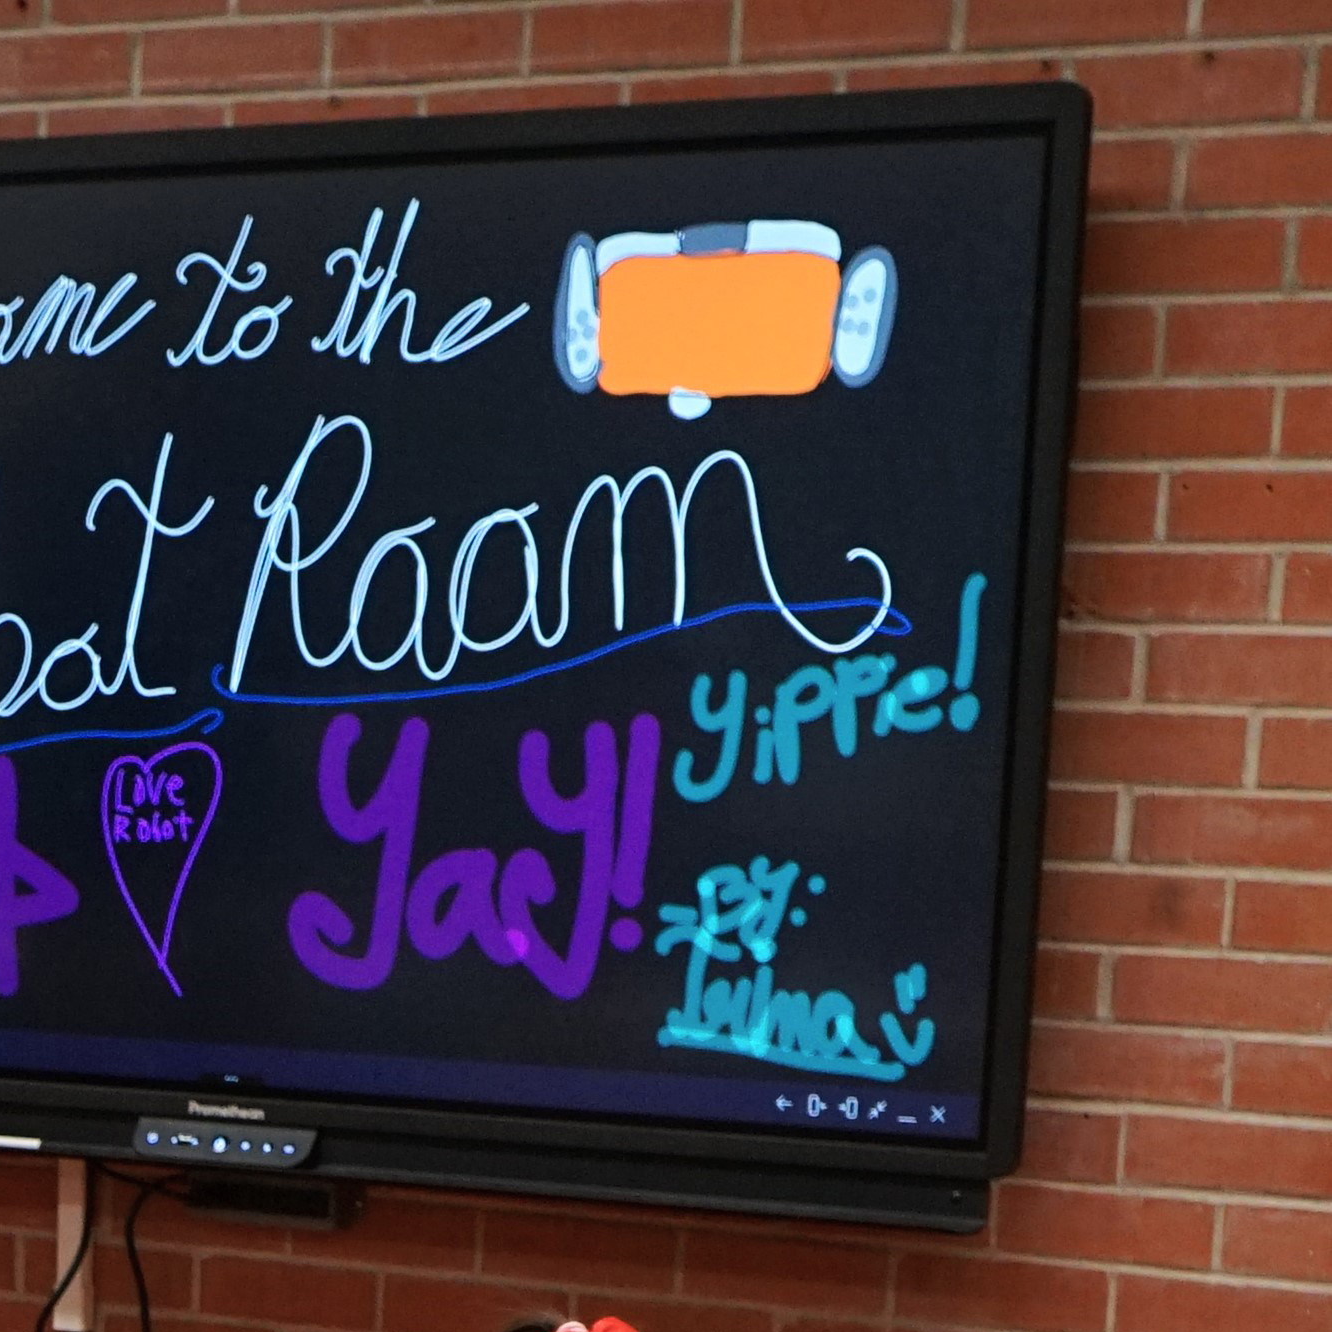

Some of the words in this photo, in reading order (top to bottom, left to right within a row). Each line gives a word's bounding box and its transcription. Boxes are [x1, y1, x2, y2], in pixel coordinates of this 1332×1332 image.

[165, 213, 295, 369] to
[310, 196, 532, 366] the
[228, 413, 895, 696] Room
[113, 809, 194, 844] Robot
[114, 767, 185, 815] Love
[287, 712, 662, 1001] Yay!
